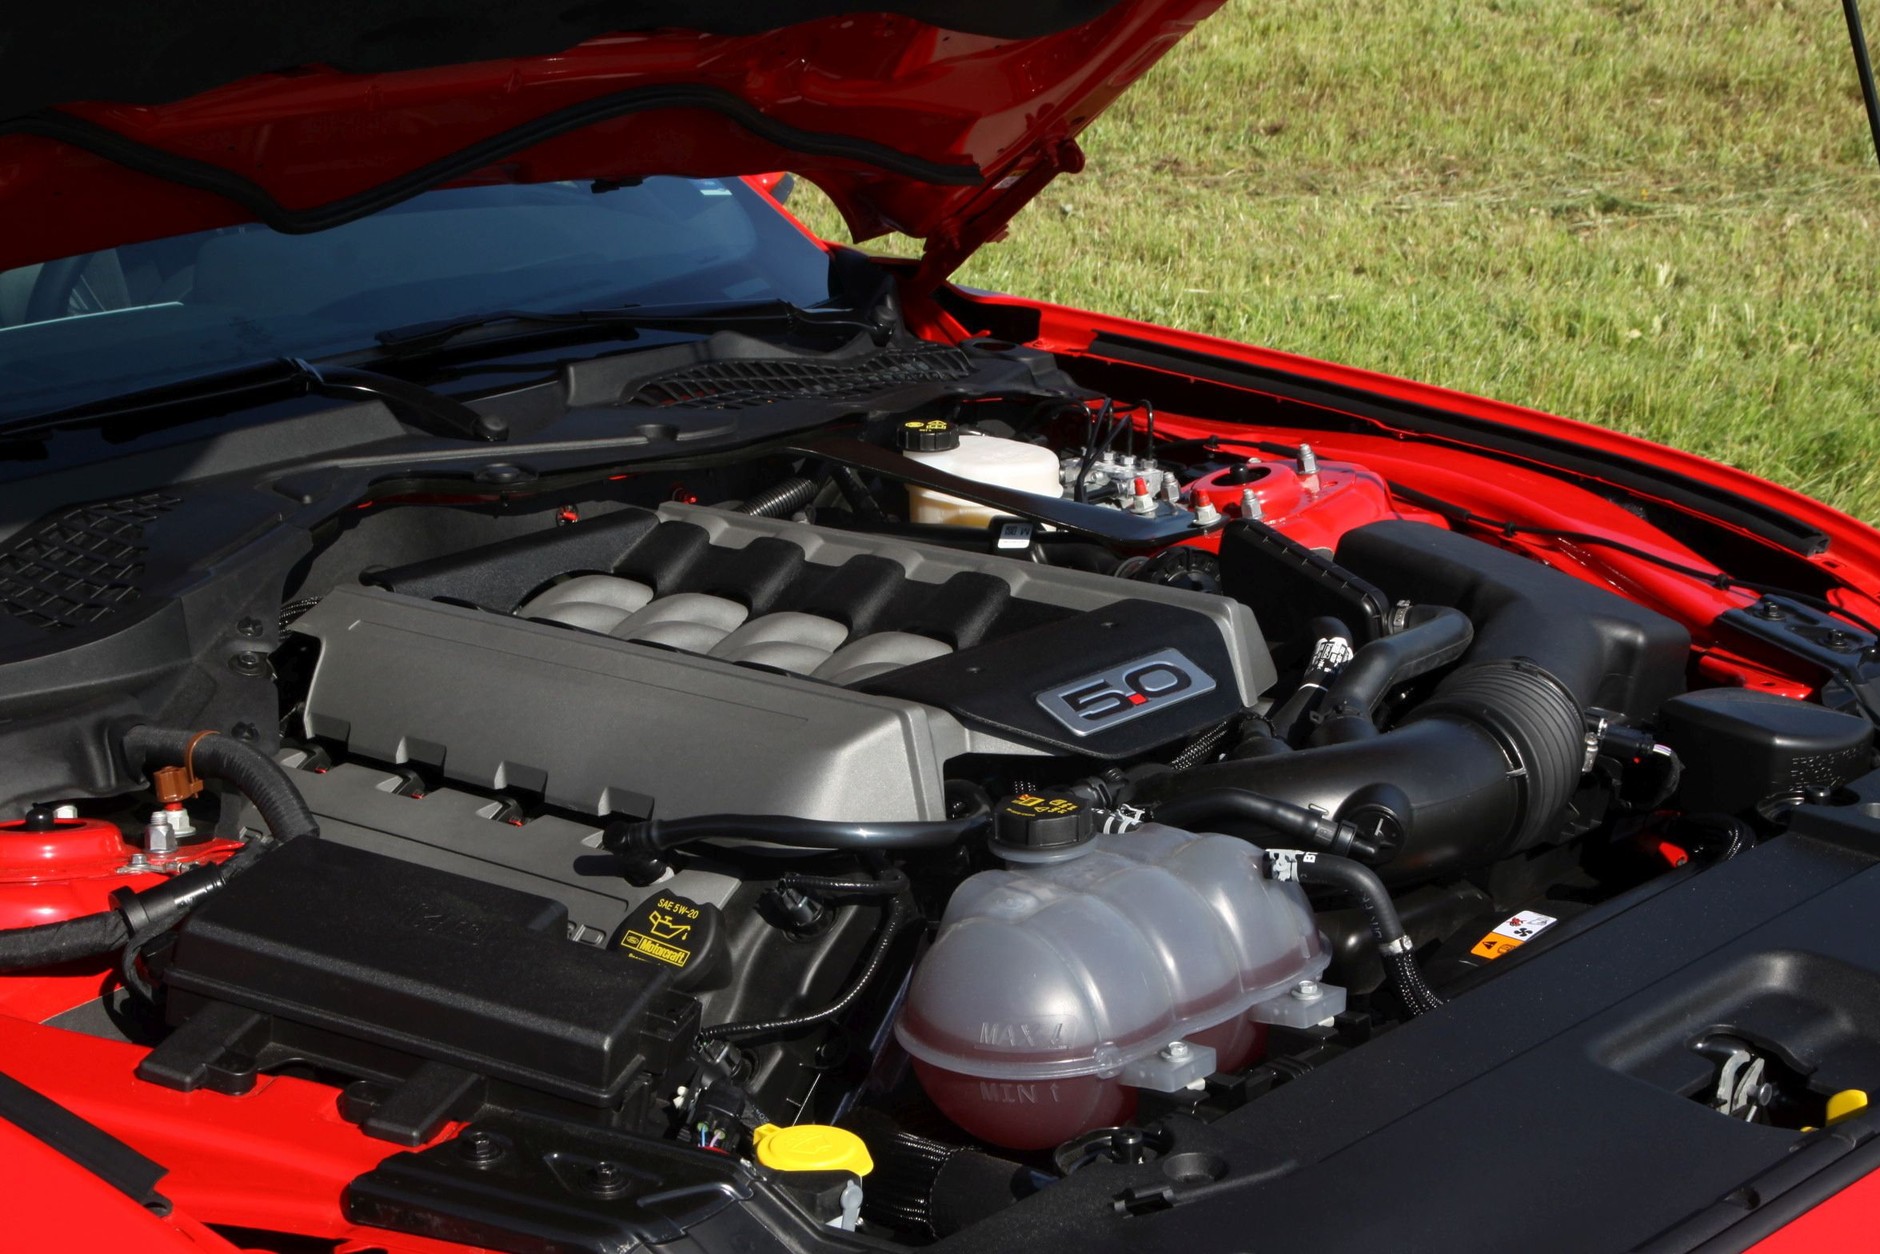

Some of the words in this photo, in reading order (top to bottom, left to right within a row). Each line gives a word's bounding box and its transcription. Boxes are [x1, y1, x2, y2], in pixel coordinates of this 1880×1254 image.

[1057, 661, 1192, 721] 5.0
[657, 898, 674, 911] SAE
[672, 903, 699, 919] 5W-20
[639, 938, 685, 964] Motorcraft
[980, 1022, 1036, 1047] MAX
[980, 1081, 1036, 1103] MIN
